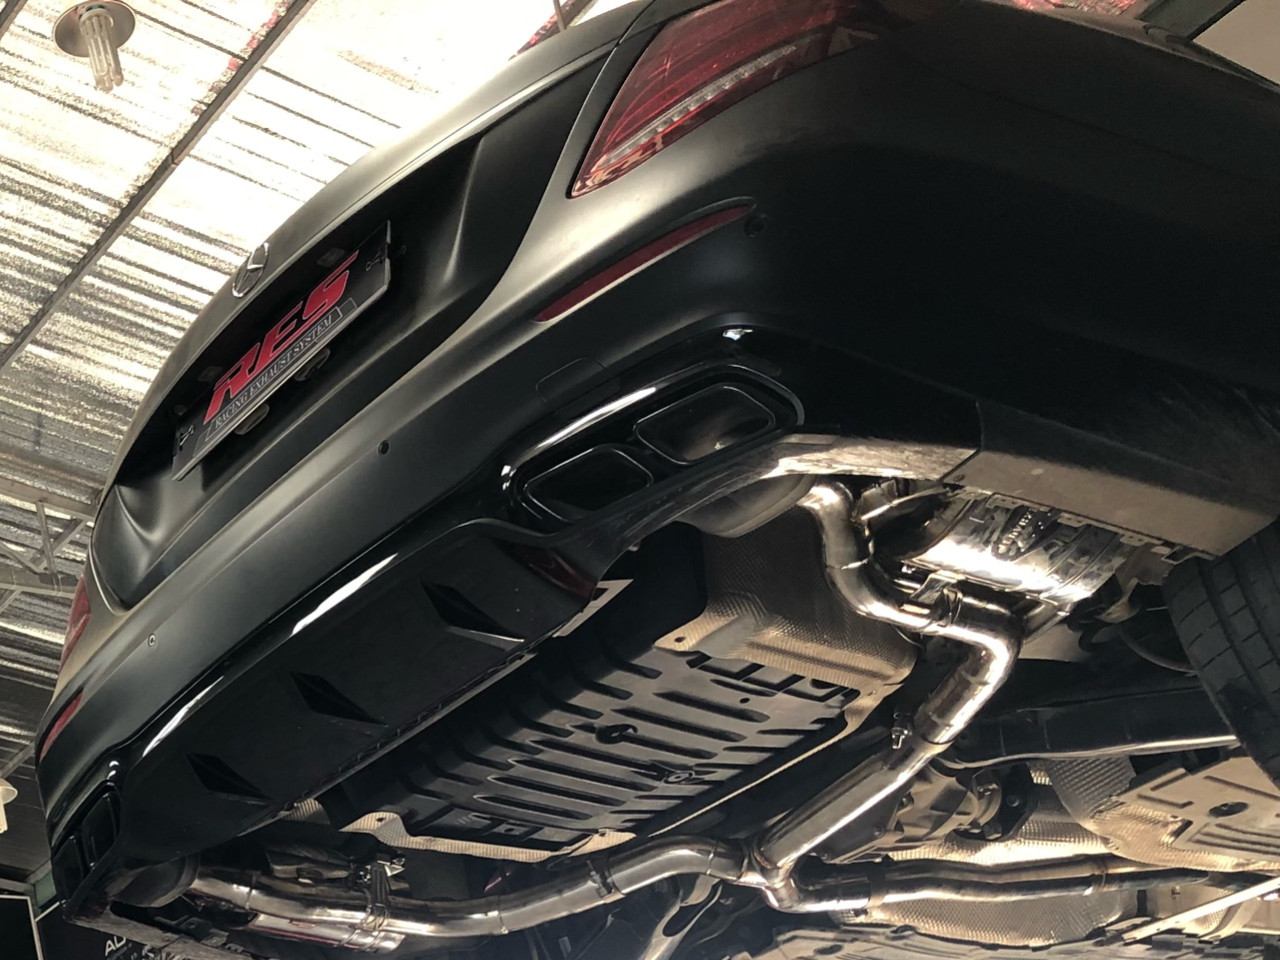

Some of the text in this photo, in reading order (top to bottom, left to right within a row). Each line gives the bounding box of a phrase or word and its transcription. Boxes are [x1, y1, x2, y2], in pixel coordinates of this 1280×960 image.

[203, 249, 360, 425] RES
[215, 313, 333, 430] RACING EXHAUST SYSTEM
